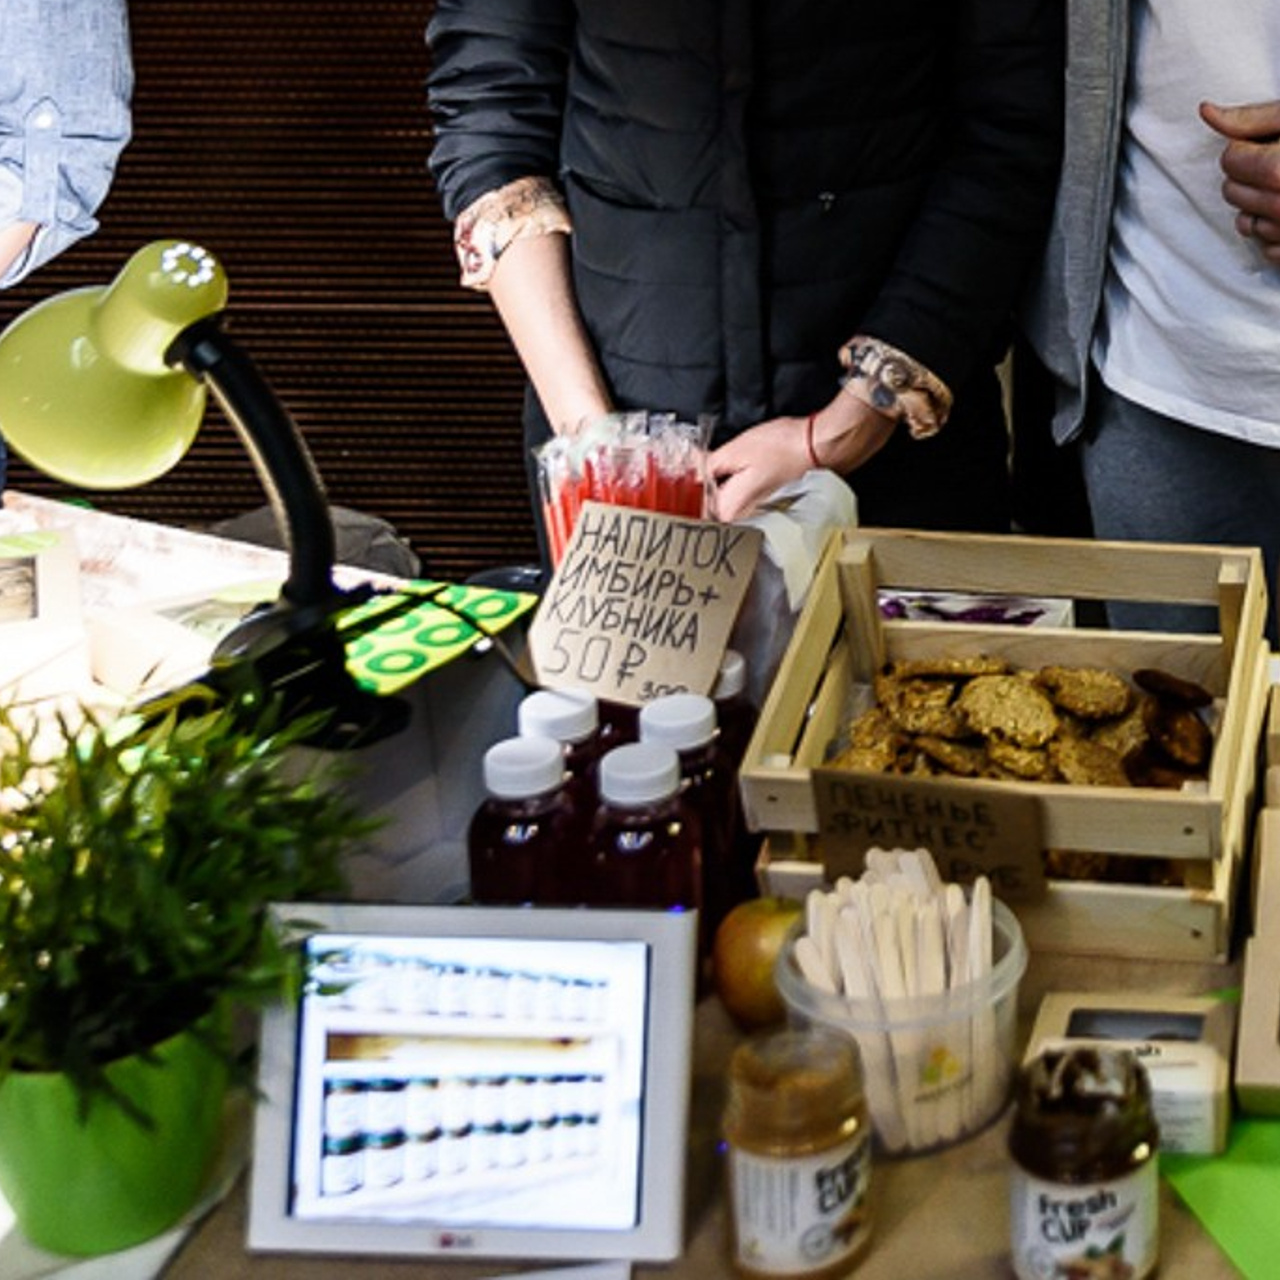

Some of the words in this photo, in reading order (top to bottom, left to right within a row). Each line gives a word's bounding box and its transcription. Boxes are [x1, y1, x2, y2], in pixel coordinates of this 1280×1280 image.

[575, 512, 747, 578] НАПИТОК
[546, 590, 700, 654] КЛУБНИКА
[542, 628, 612, 683] 50
[828, 778, 992, 827] ПЕЧЕНЬЕ
